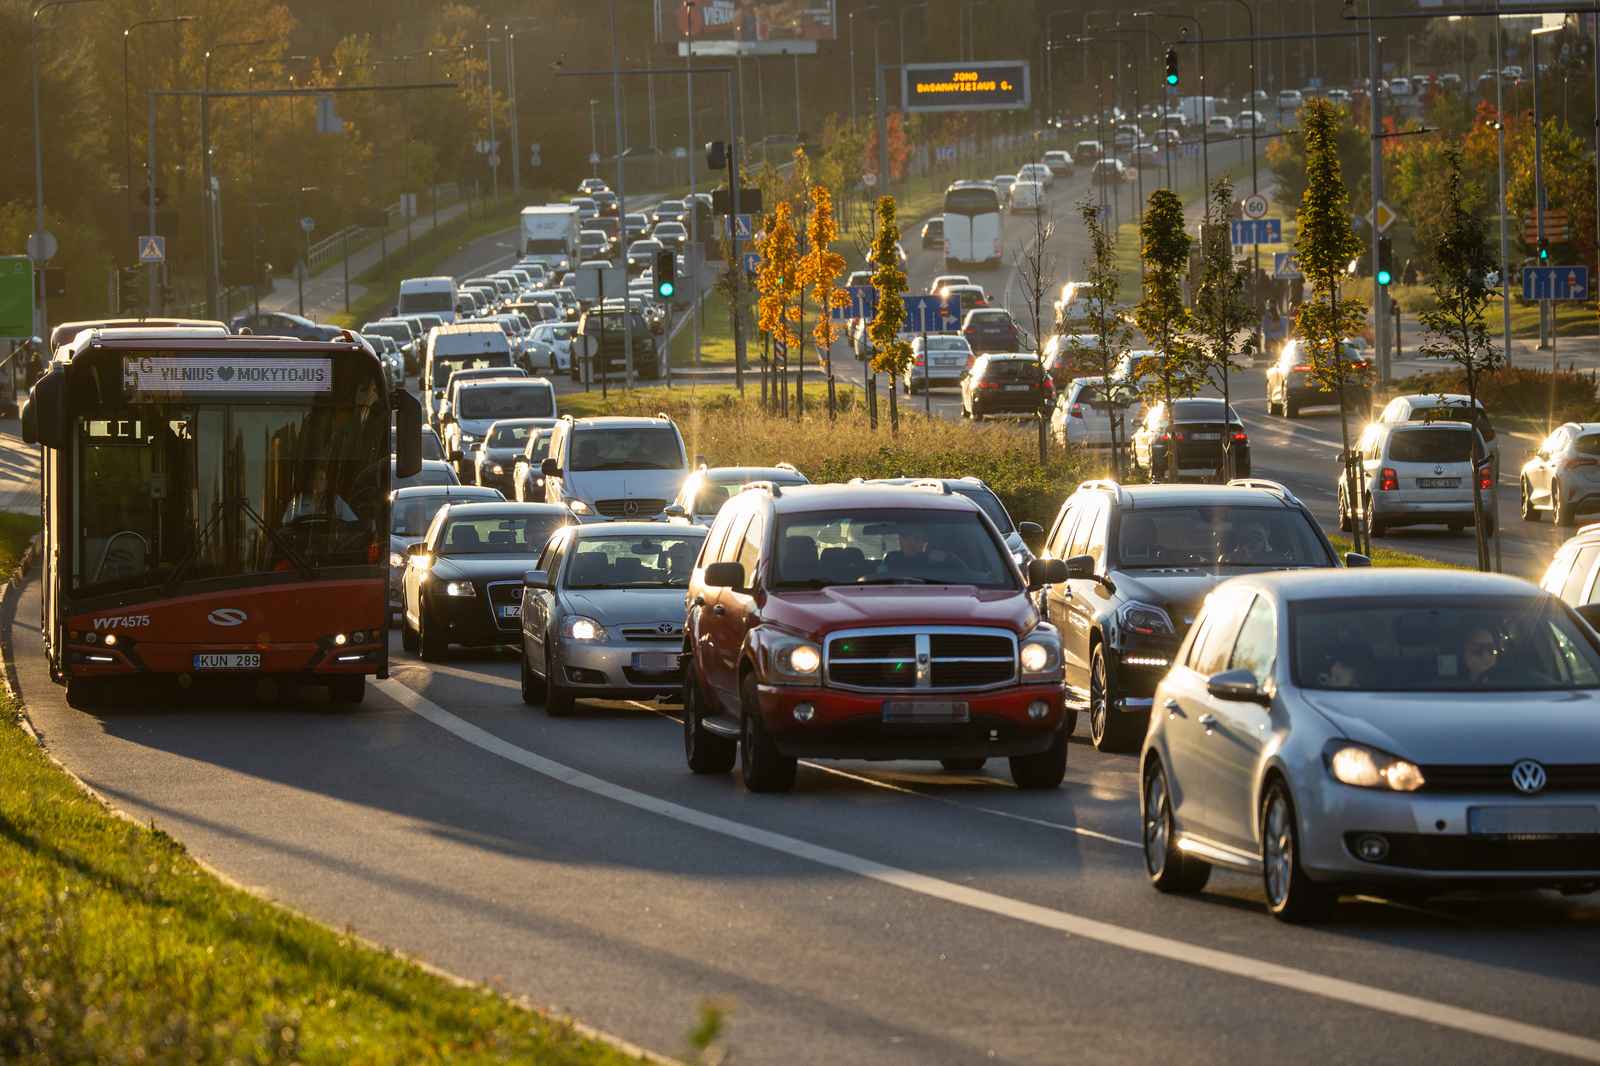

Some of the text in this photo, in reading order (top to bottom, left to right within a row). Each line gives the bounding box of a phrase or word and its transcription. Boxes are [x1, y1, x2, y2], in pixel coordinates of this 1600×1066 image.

[953, 71, 978, 82] JONO
[1249, 201, 1264, 212] 60
[161, 366, 215, 382] VILNIUS
[237, 367, 325, 382] MOKYTOJUS
[201, 655, 259, 667] KUN 289
